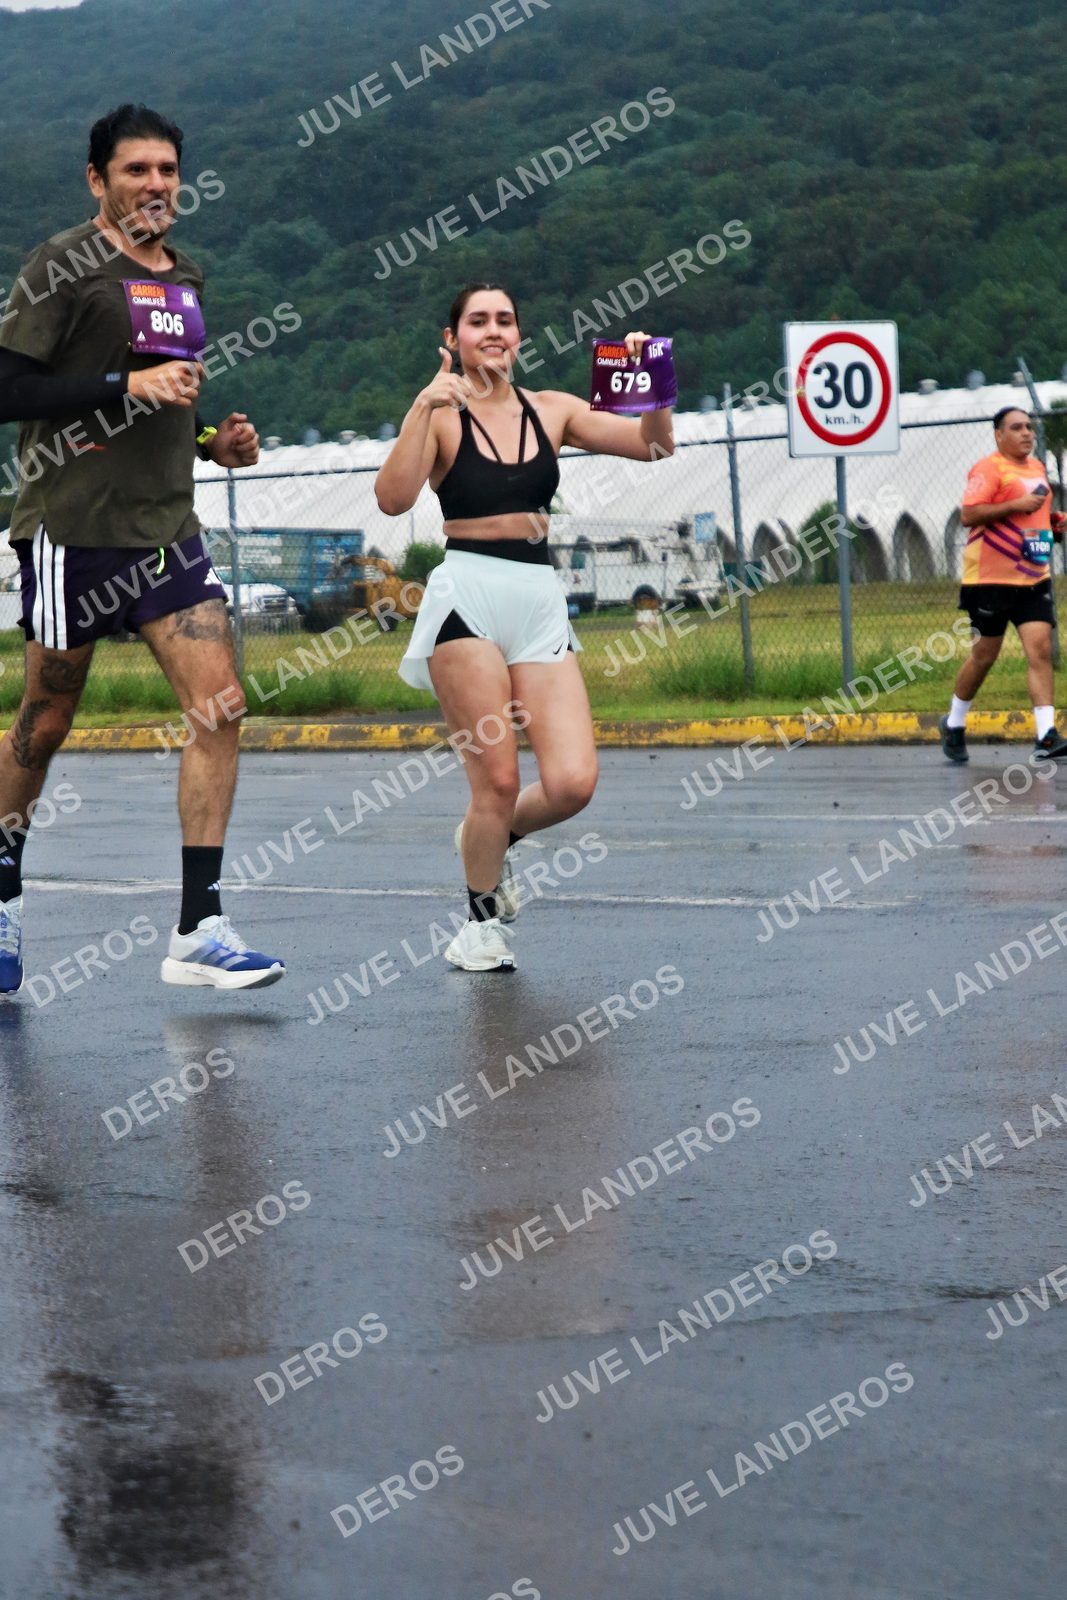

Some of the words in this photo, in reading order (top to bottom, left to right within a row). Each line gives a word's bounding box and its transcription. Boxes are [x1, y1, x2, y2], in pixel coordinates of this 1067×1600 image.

[150, 310, 184, 336] 806
[611, 371, 651, 393] 679
[812, 361, 872, 409] 30
